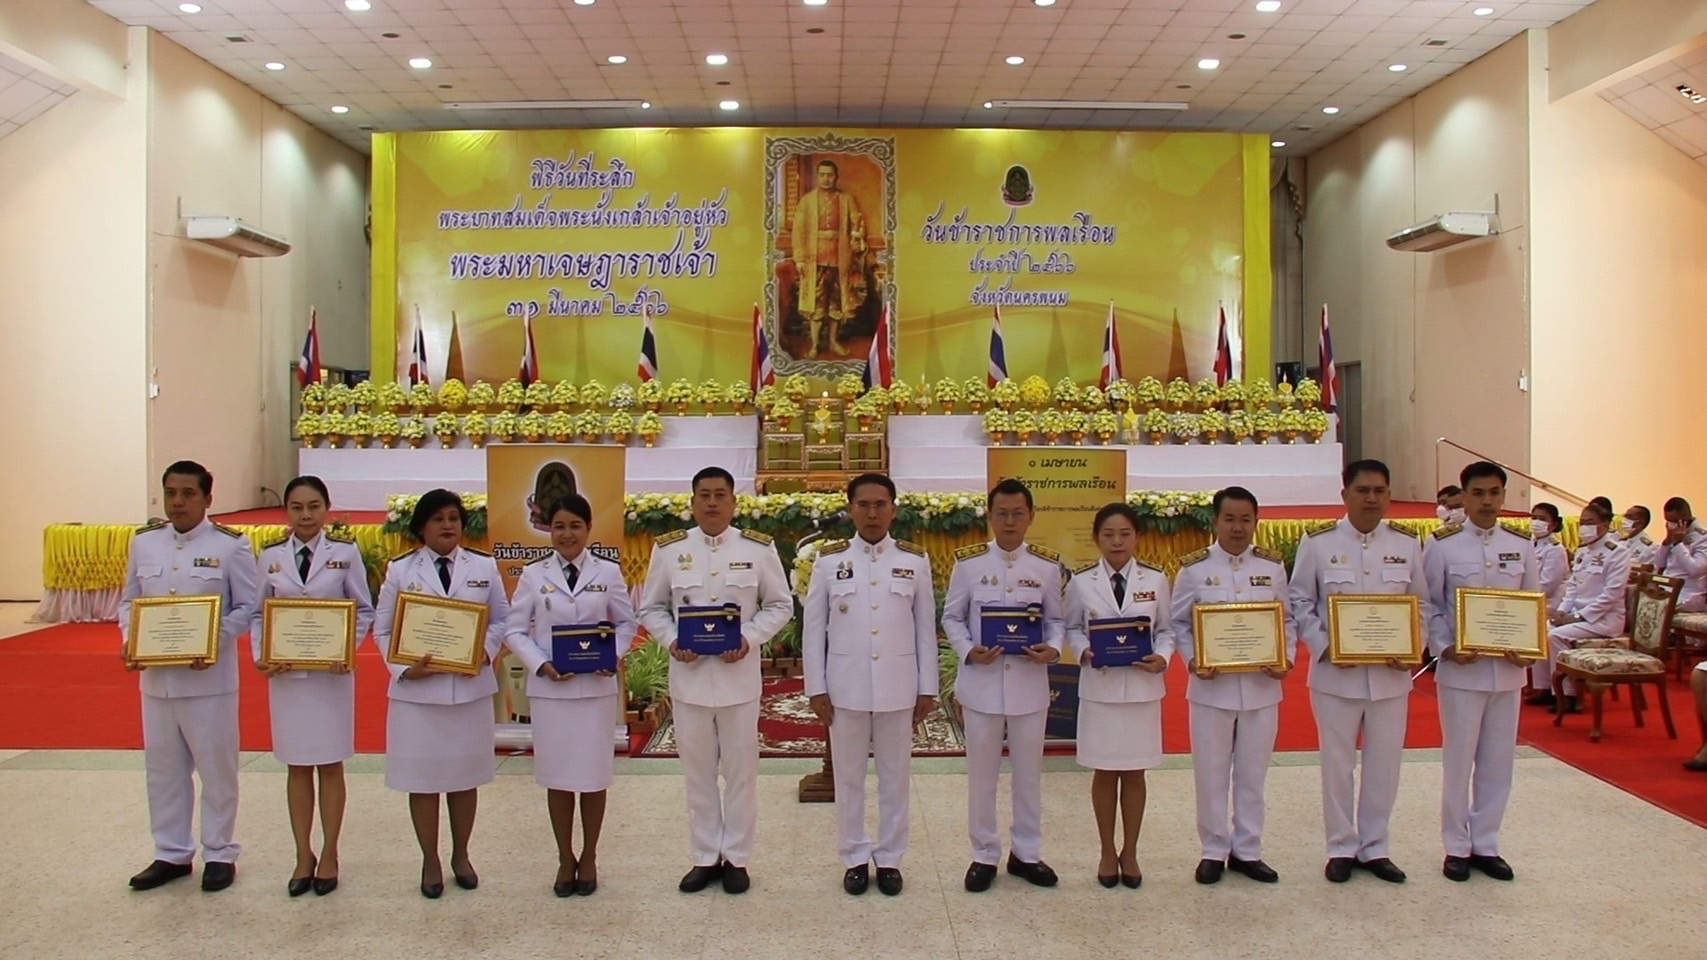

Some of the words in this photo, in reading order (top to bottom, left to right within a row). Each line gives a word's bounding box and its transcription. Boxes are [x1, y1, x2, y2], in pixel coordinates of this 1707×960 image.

[531, 150, 635, 188] พิธีวันที่ระลึก
[438, 188, 728, 236] พระบาทสมเด็จพระนั่งเกล้าเจ้าอยู่หัว
[921, 201, 1115, 244] วันข้าราชการพลเรือน
[450, 230, 716, 288] พระมหาเจษฎาราชเจ้า
[969, 248, 1023, 273] ประจำปี
[548, 289, 602, 315] มีนาคม
[970, 277, 1067, 305] จังหวัดนครพนม
[1040, 458, 1089, 468] เมษายน
